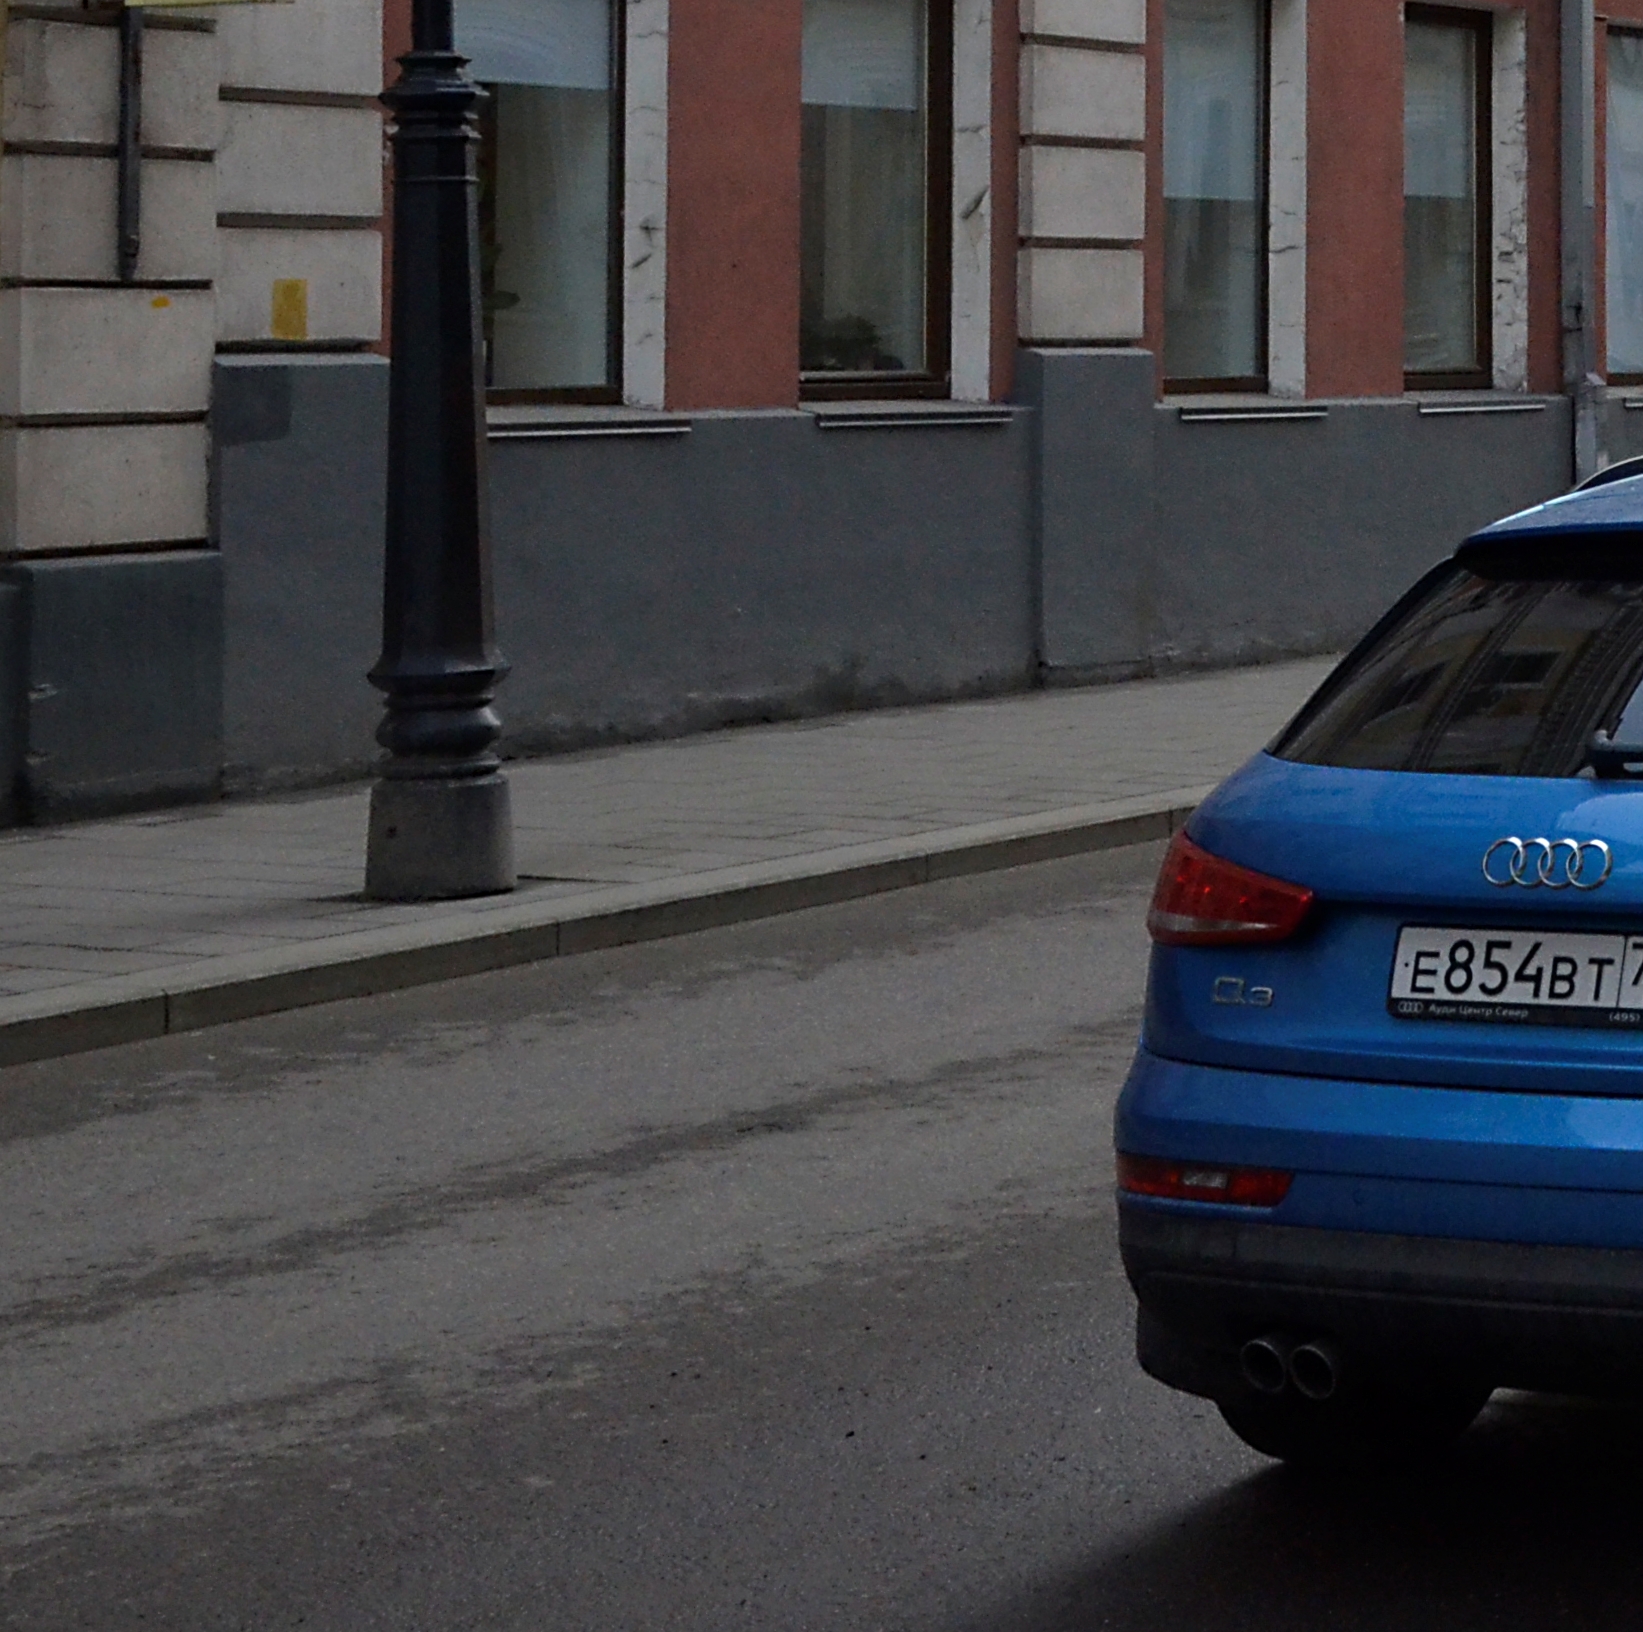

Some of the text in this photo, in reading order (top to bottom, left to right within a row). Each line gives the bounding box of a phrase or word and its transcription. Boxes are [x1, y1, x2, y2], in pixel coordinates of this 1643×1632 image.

[1214, 976, 1274, 1007] Q3
[1428, 1002, 1529, 1019] Ауди Центр Север
[1609, 1012, 1641, 1023] (495)
